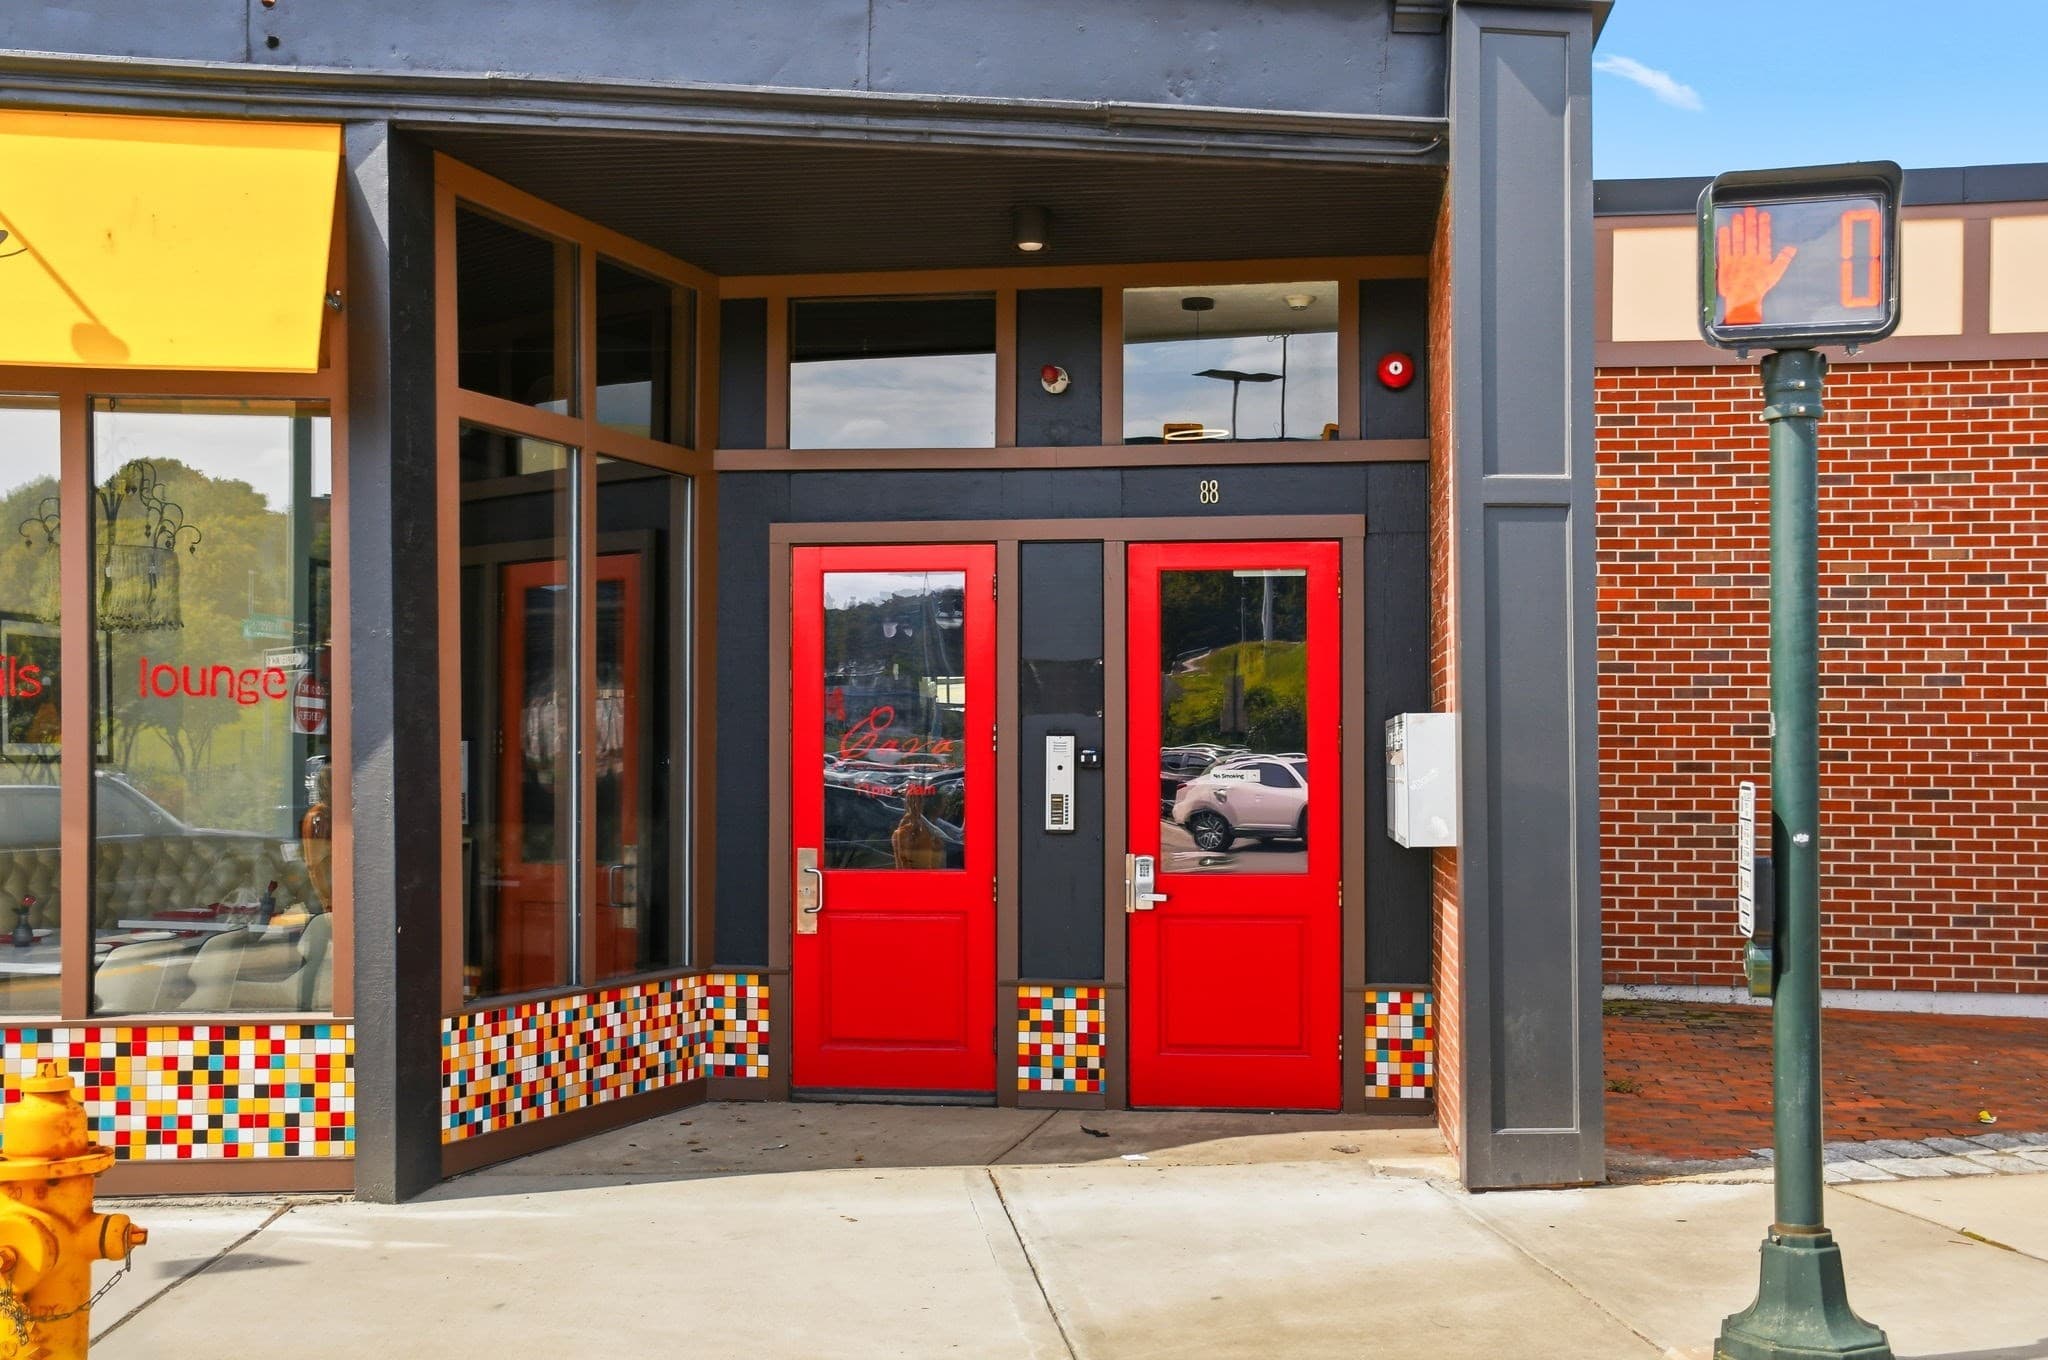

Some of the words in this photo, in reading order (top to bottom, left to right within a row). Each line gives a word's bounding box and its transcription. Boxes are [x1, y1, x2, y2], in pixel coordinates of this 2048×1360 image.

[1840, 208, 1881, 308] 0
[1200, 480, 1219, 504] 88
[139, 656, 288, 705] lounge
